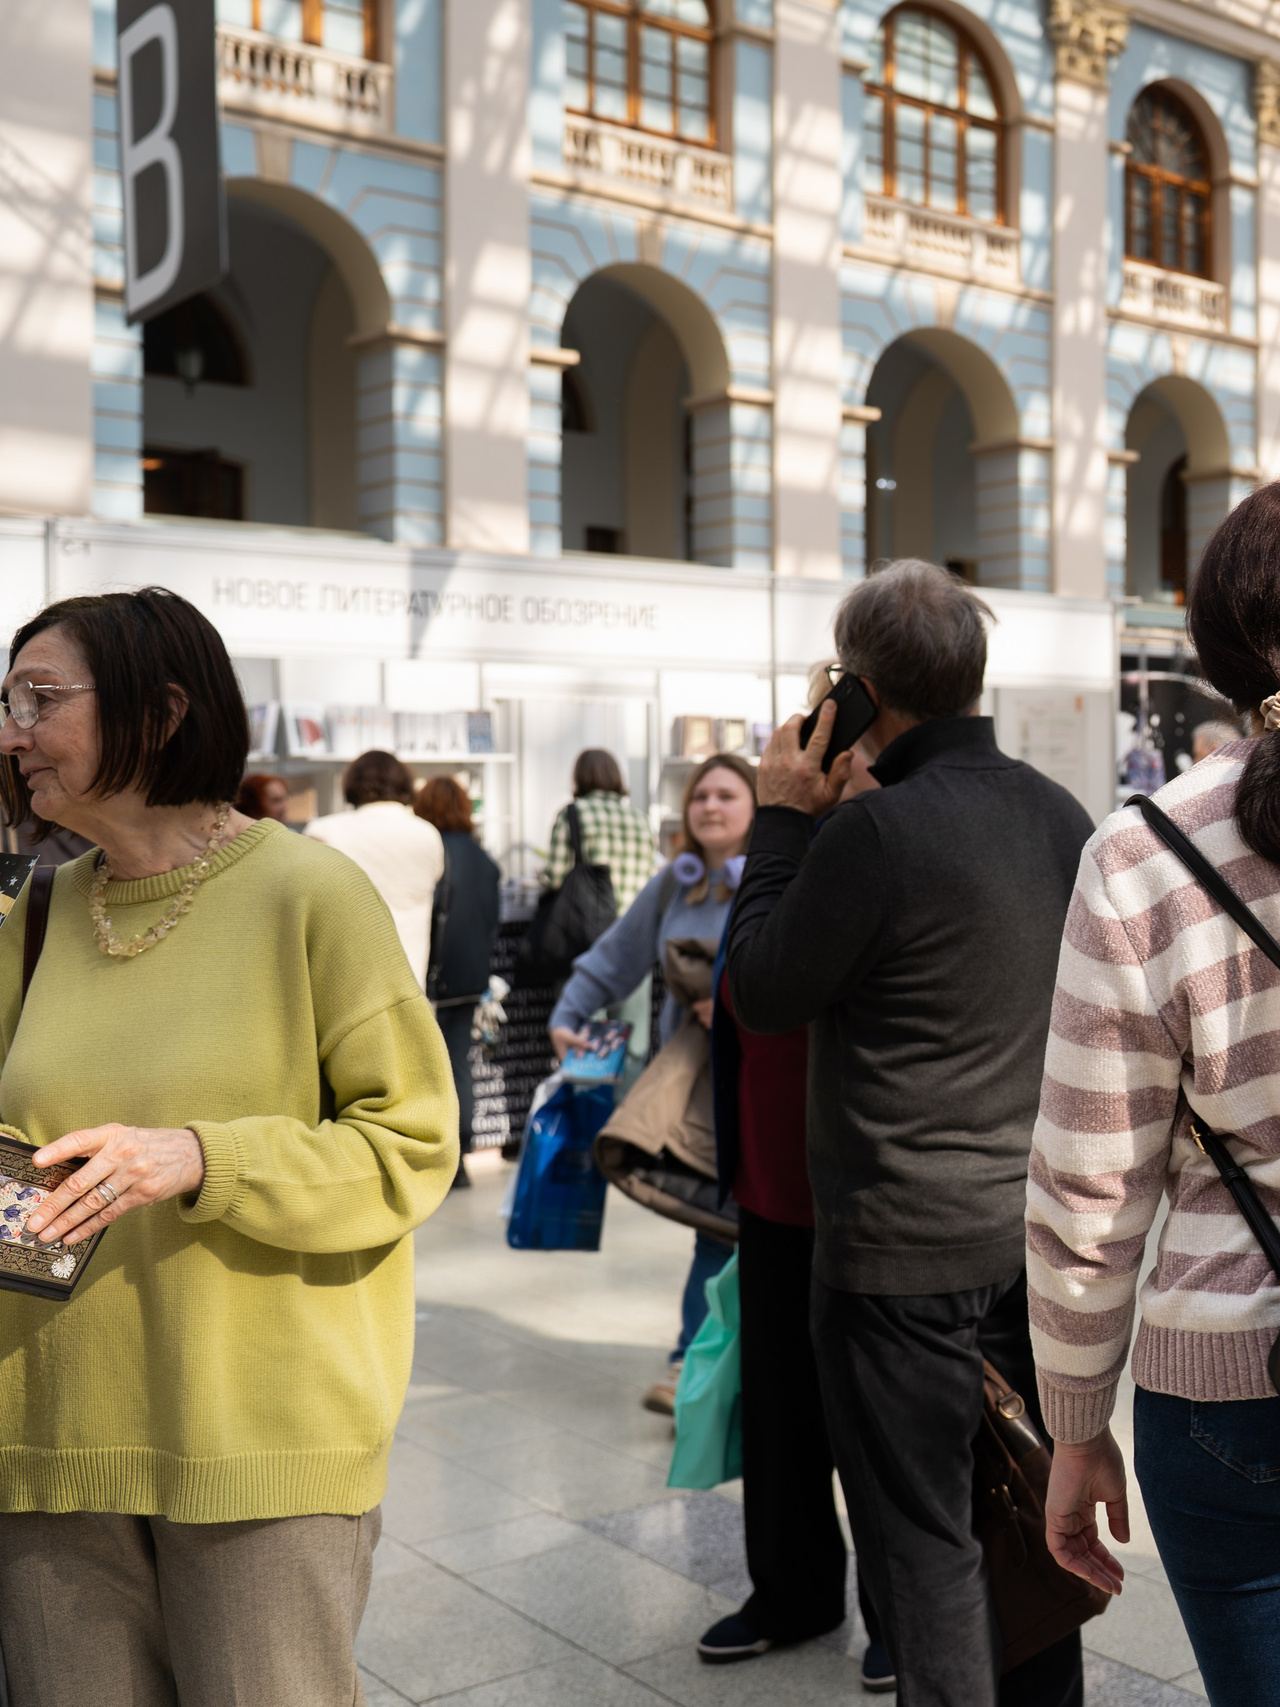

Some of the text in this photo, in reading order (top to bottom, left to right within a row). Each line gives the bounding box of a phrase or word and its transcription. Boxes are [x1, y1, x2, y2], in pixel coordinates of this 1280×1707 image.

[212, 576, 658, 630] НОВОЕ ЛИТЕРАТУРНОЕ ОБОЗРЕНИЕ
